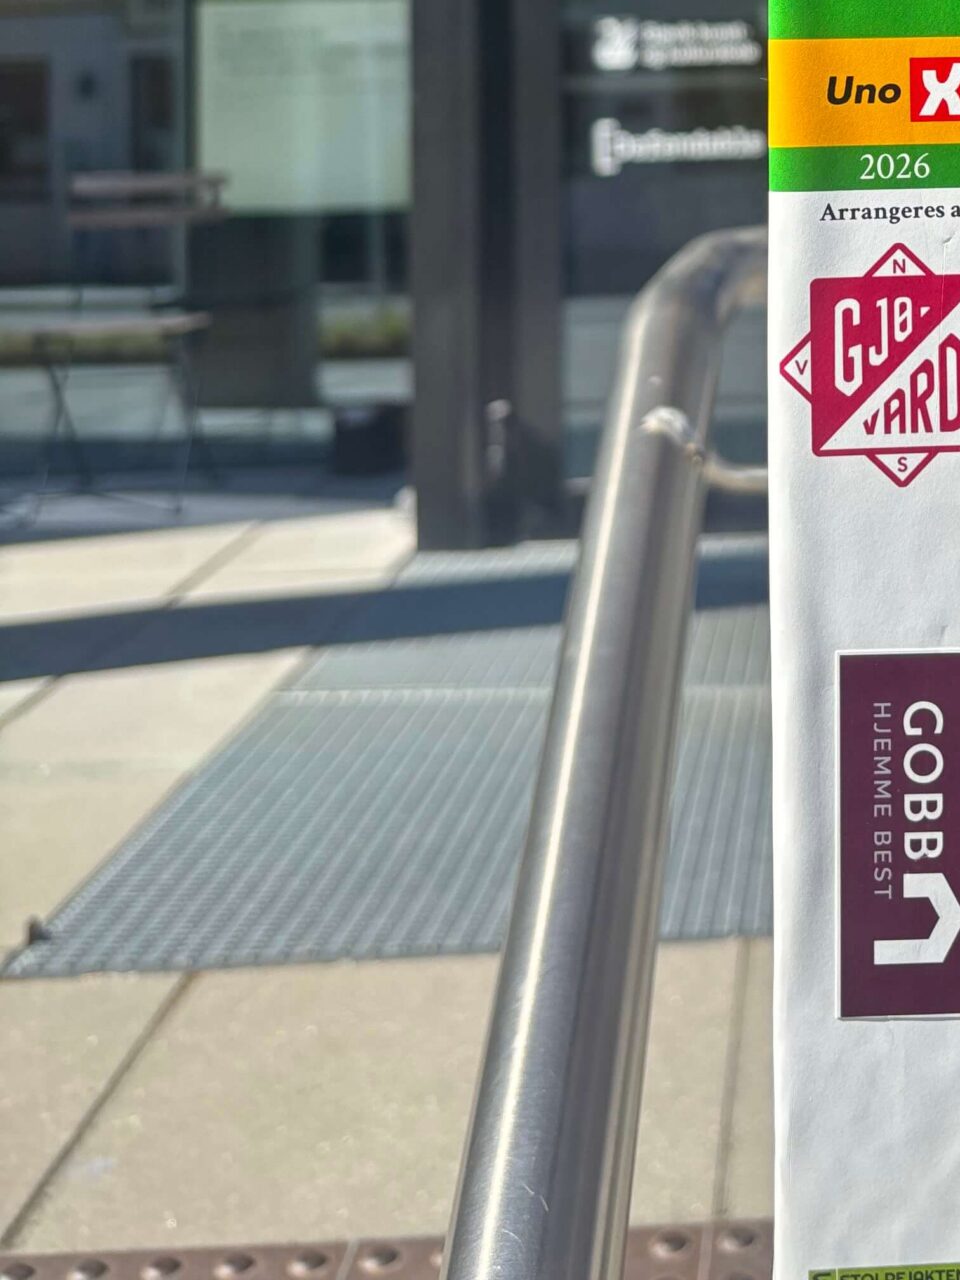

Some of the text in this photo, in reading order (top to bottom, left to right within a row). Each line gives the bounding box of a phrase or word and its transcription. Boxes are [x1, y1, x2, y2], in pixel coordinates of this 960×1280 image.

[826, 75, 902, 106] Uno
[859, 152, 931, 180] 2026
[819, 202, 946, 224] Arrangeres
[892, 258, 906, 274] N
[795, 359, 809, 376] V
[896, 456, 908, 473] S
[902, 700, 944, 860] GOBB
[872, 702, 893, 900] HJEMME BEST
